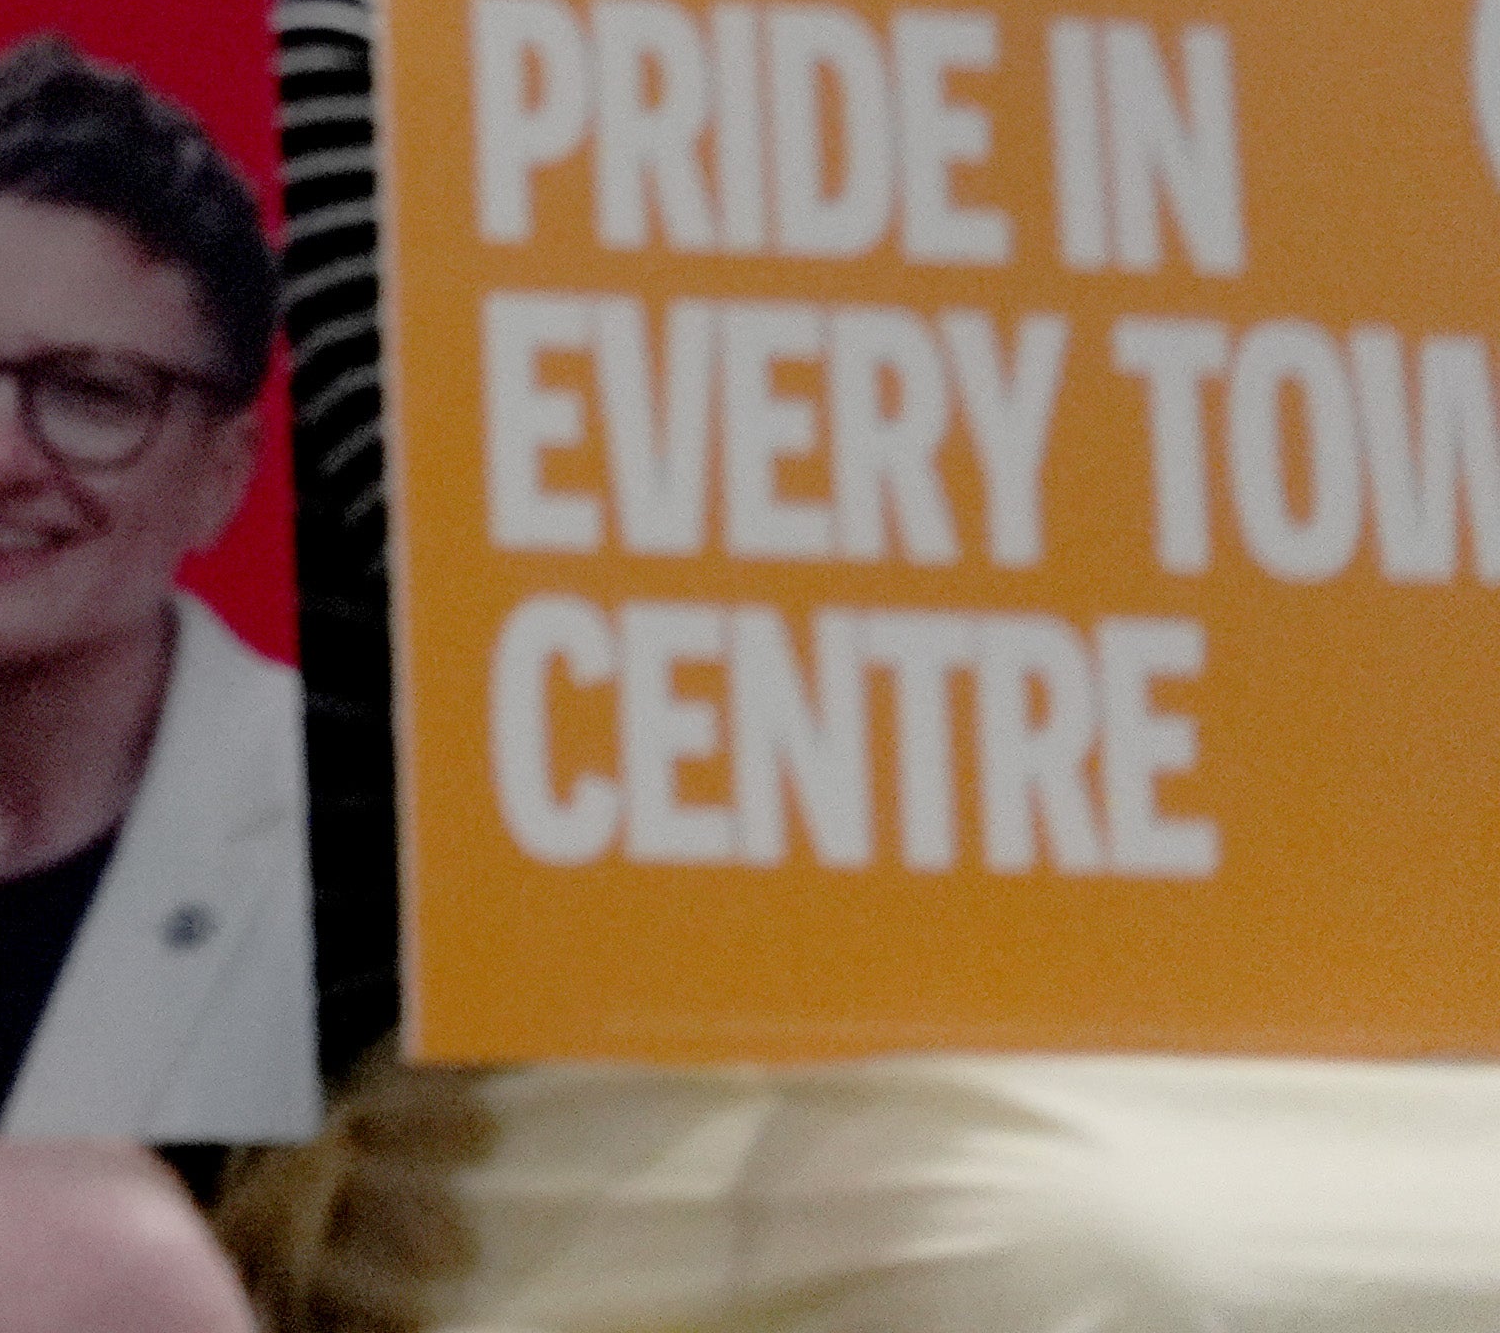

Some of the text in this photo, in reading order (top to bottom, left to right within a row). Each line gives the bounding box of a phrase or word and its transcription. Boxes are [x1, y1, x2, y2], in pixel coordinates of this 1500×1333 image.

[1046, 15, 1248, 278] IN
[481, 288, 1072, 569] EVERY
[490, 592, 1222, 880] CENTRE
